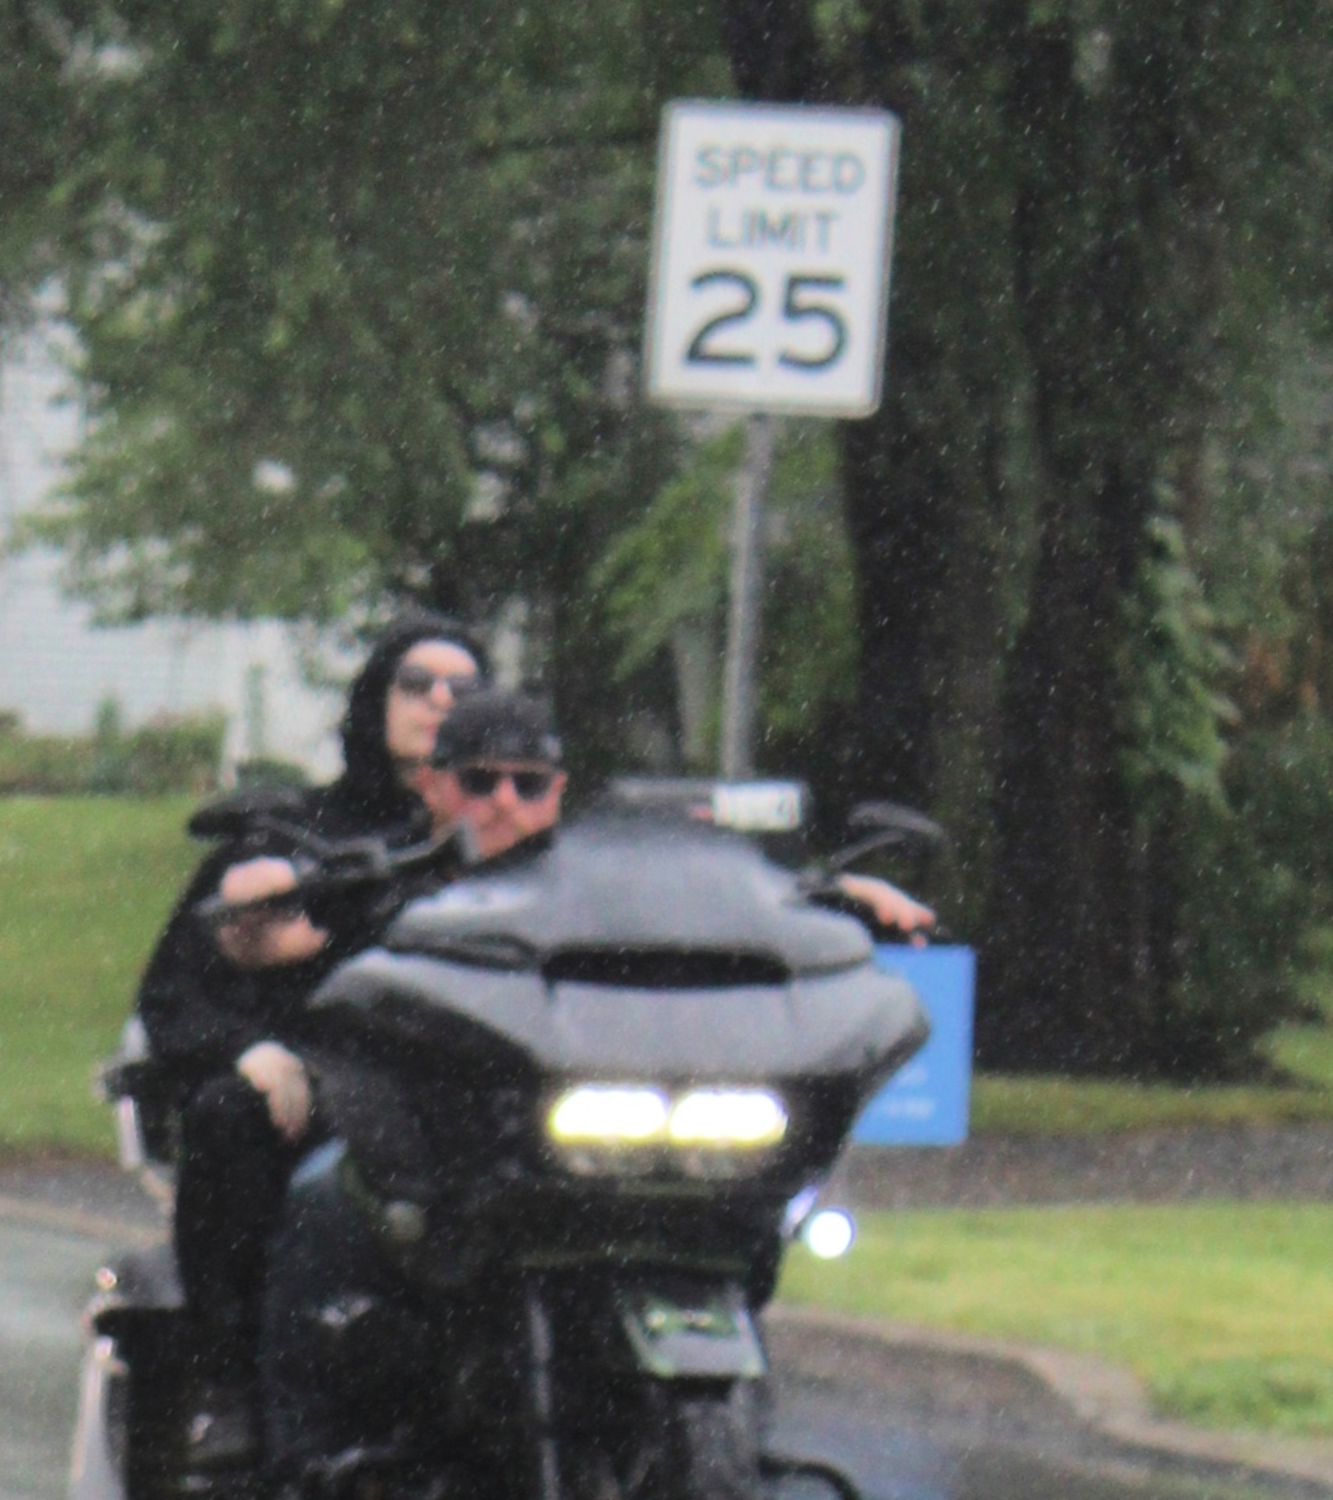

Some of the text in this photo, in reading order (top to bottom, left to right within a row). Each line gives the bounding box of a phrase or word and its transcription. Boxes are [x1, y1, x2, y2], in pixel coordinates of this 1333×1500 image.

[694, 146, 866, 193] SPEED
[707, 208, 839, 251] LIMIT
[685, 268, 850, 373] 25
